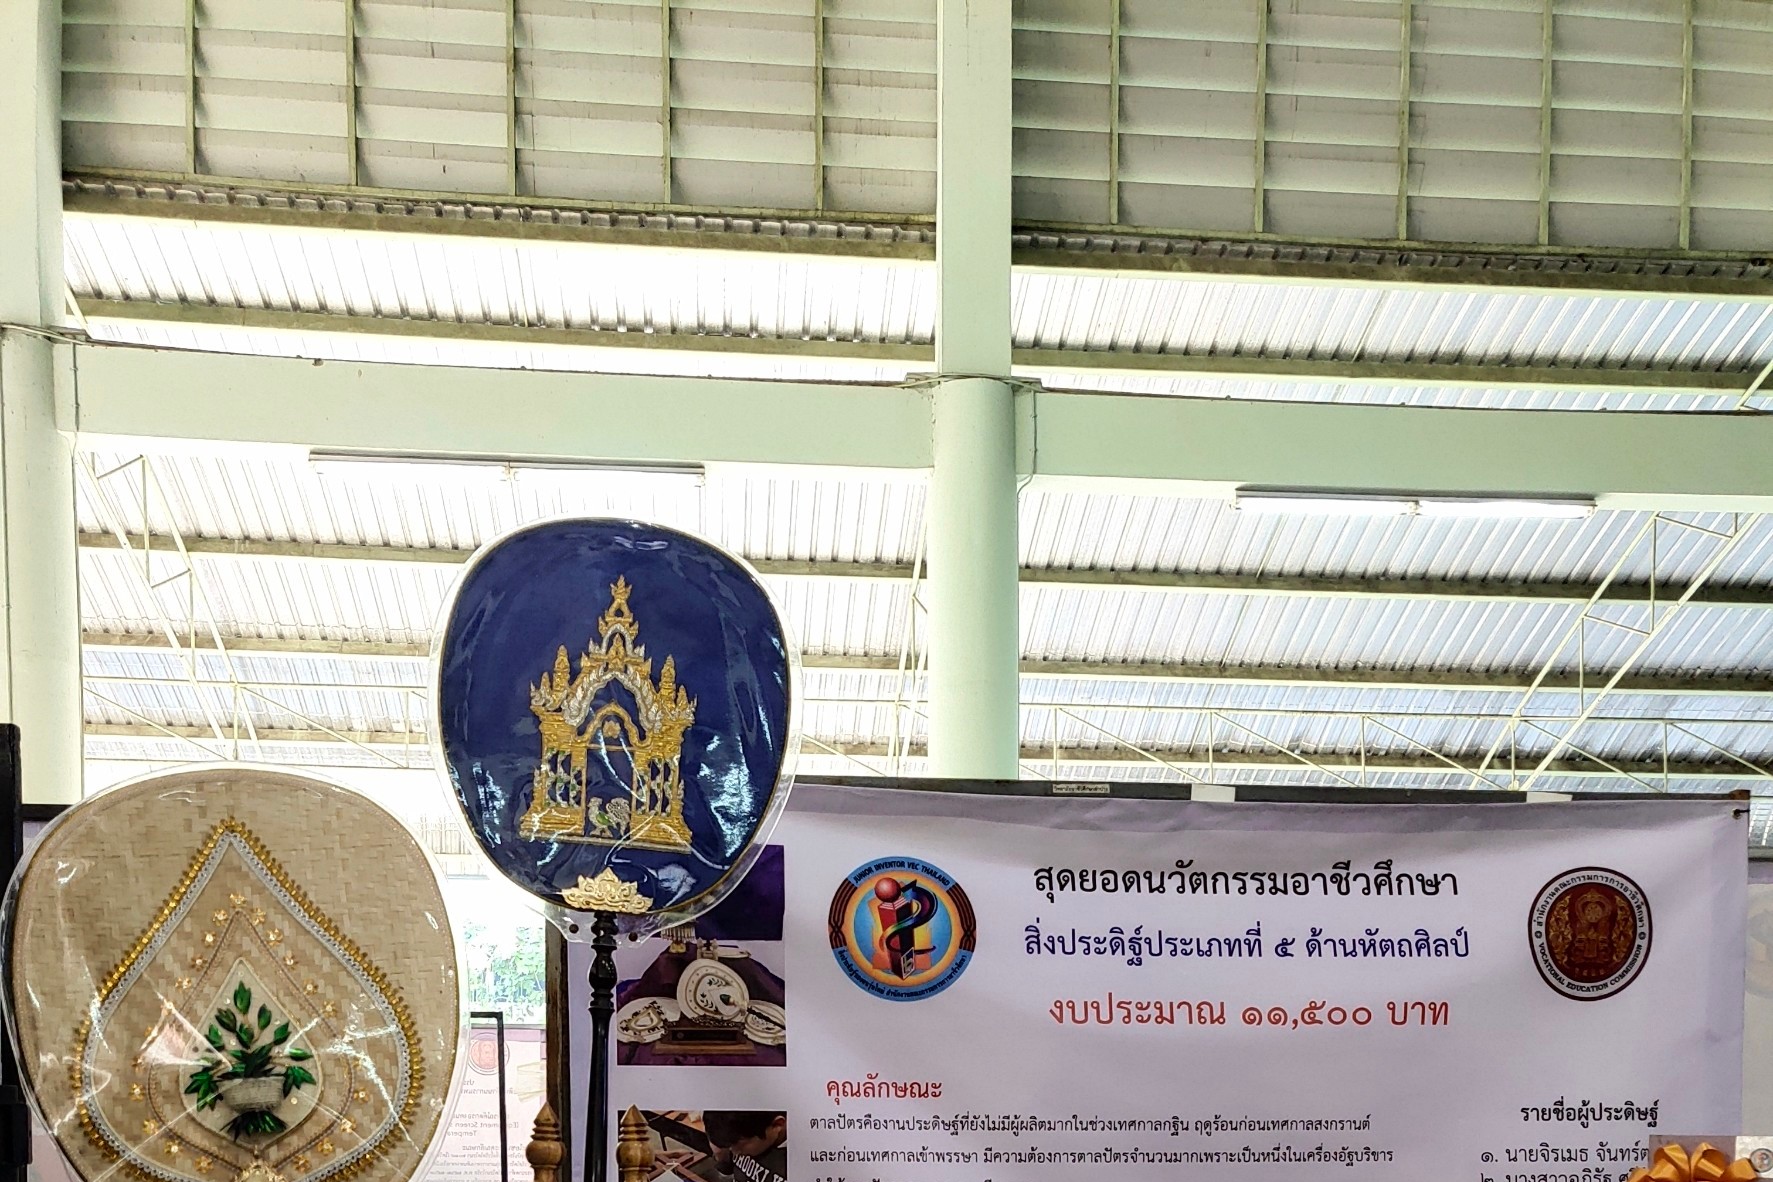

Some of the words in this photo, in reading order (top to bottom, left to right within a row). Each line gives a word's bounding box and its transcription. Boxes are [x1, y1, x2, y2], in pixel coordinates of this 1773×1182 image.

[853, 865, 874, 884] JUNIOR
[875, 860, 906, 872] INVENTOR
[907, 861, 920, 871] VEC
[921, 865, 951, 887] THAILAND
[1033, 858, 1459, 904] สุดยอดนวัตกรรมอาชีวศึกษา
[1274, 937, 1296, 958] ๕
[1305, 925, 1470, 958] ด้านหัตถศิลป์
[1537, 941, 1566, 986] VOCATIONAL
[1566, 981, 1609, 993] EDUCATION
[1610, 943, 1643, 987] COMMISSION
[1048, 991, 1226, 1025] งบประมาณ
[1241, 1000, 1372, 1031] ๑๑,๕๐๐
[1386, 1000, 1449, 1026] บาท
[826, 1072, 943, 1106] คุณลักษณะ
[1194, 1113, 1372, 1137] ฤดูร้อนก่อนเทศกาลสงกรานต์
[1520, 1095, 1660, 1129] รายชื่อผู้ประดิษฐ์
[810, 1145, 978, 1164] และก่อนเทศกาลเข้าพรรษา
[1480, 1151, 1499, 1163] ๑.
[1505, 1141, 1589, 1163] นายจิรเมธ
